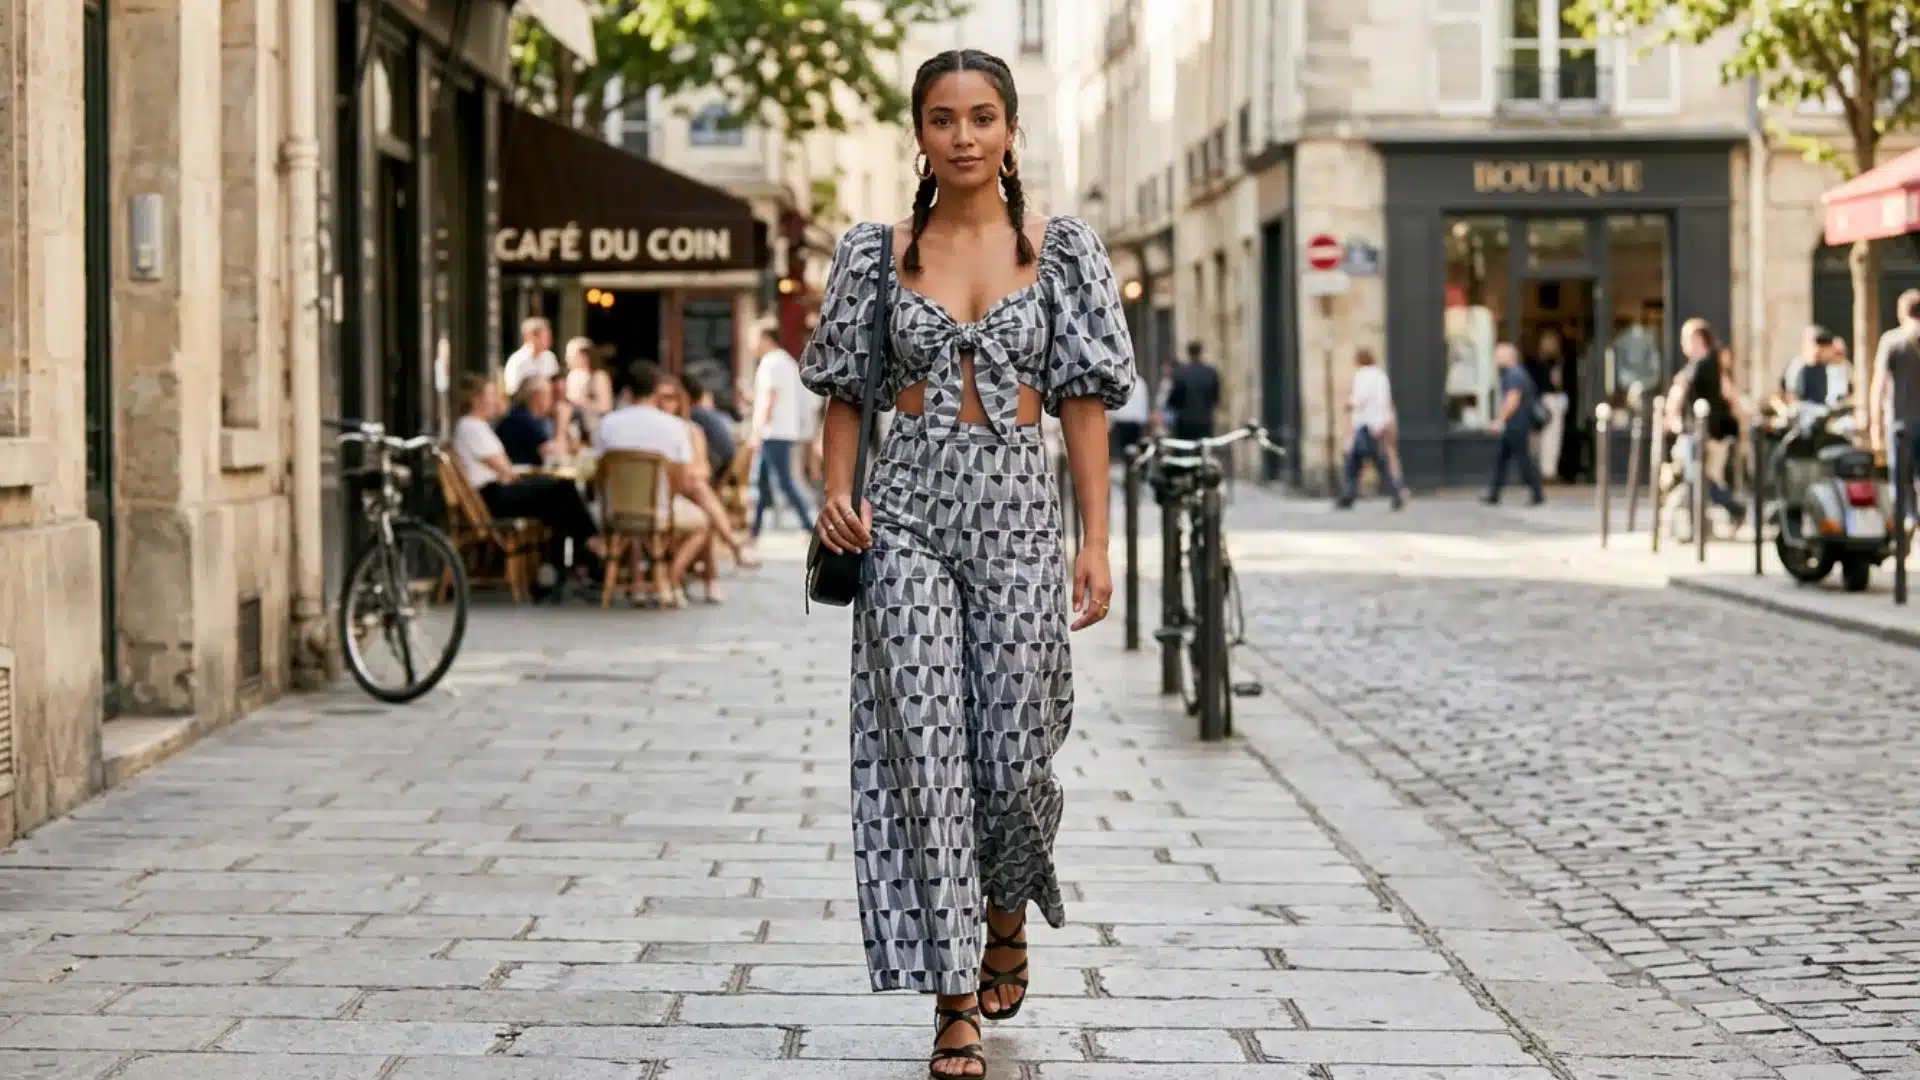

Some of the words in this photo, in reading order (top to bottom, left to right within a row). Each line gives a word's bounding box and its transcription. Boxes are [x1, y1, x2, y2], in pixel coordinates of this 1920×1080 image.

[1473, 160, 1643, 196] BOUTIQUE
[495, 220, 582, 261] CAFÉ
[590, 228, 638, 261] DU
[647, 228, 731, 261] COIN
